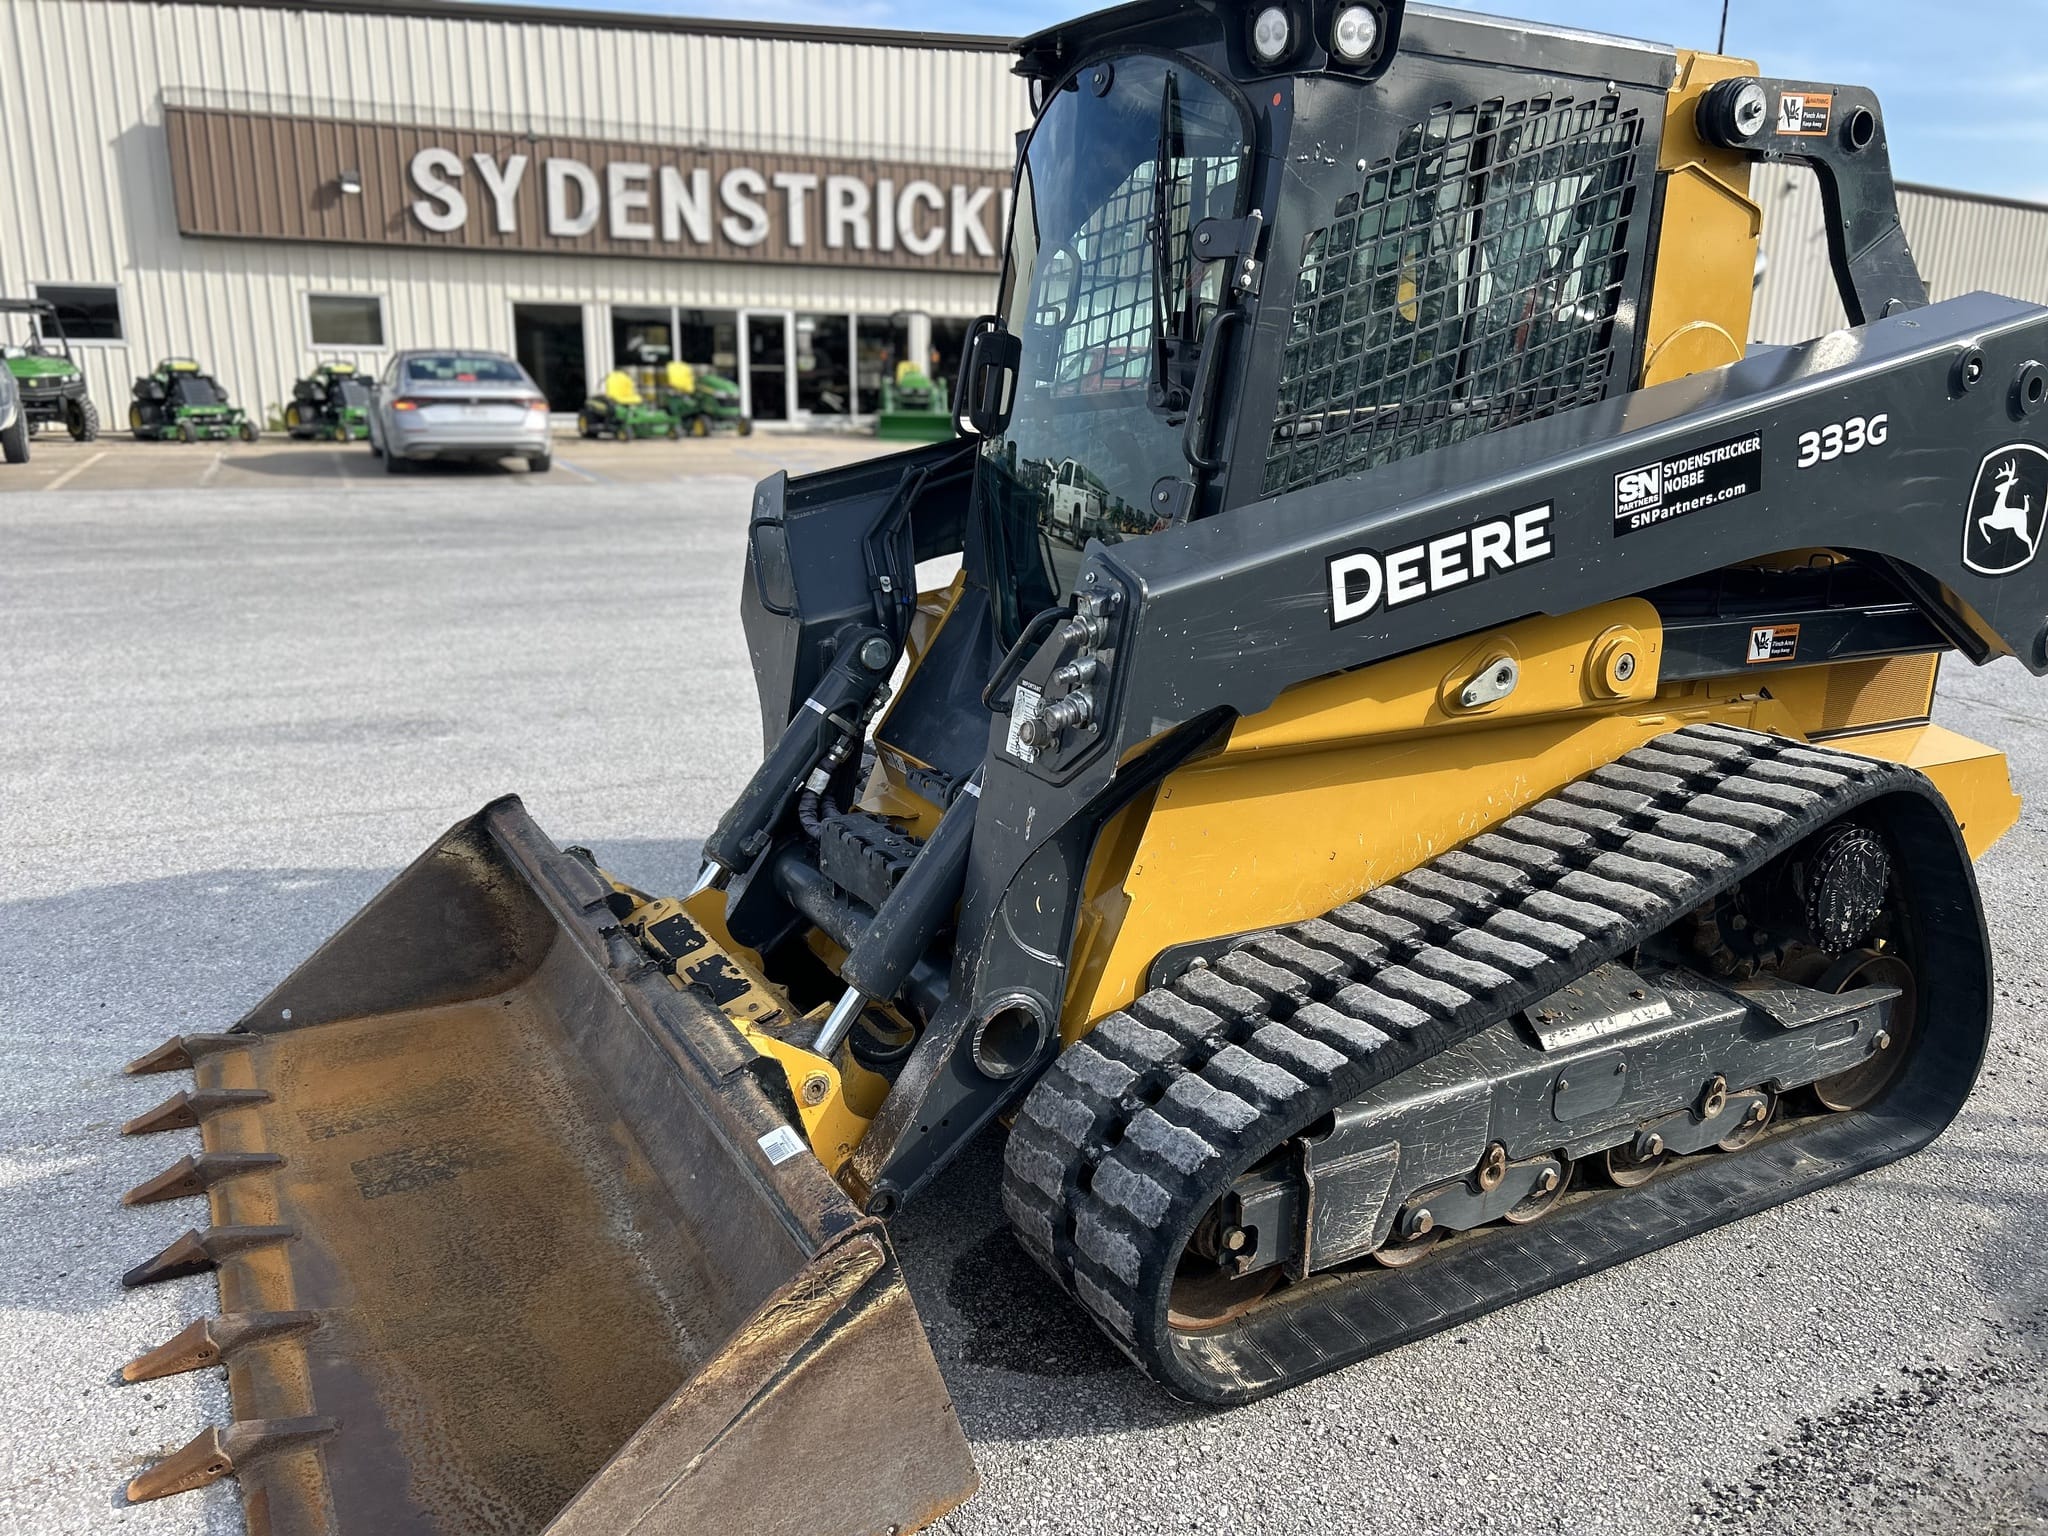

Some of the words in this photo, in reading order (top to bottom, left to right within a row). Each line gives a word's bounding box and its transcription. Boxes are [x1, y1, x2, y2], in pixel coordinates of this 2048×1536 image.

[1663, 437, 1761, 478] SYDENSTRICKER
[1797, 413, 1888, 468] 333G
[1618, 468, 1659, 503] SN
[1663, 470, 1705, 495] NOBBE
[1618, 494, 1659, 513] PARTNERS
[1631, 483, 1746, 529] SNPartners.com
[1330, 505, 1551, 623] DEERE
